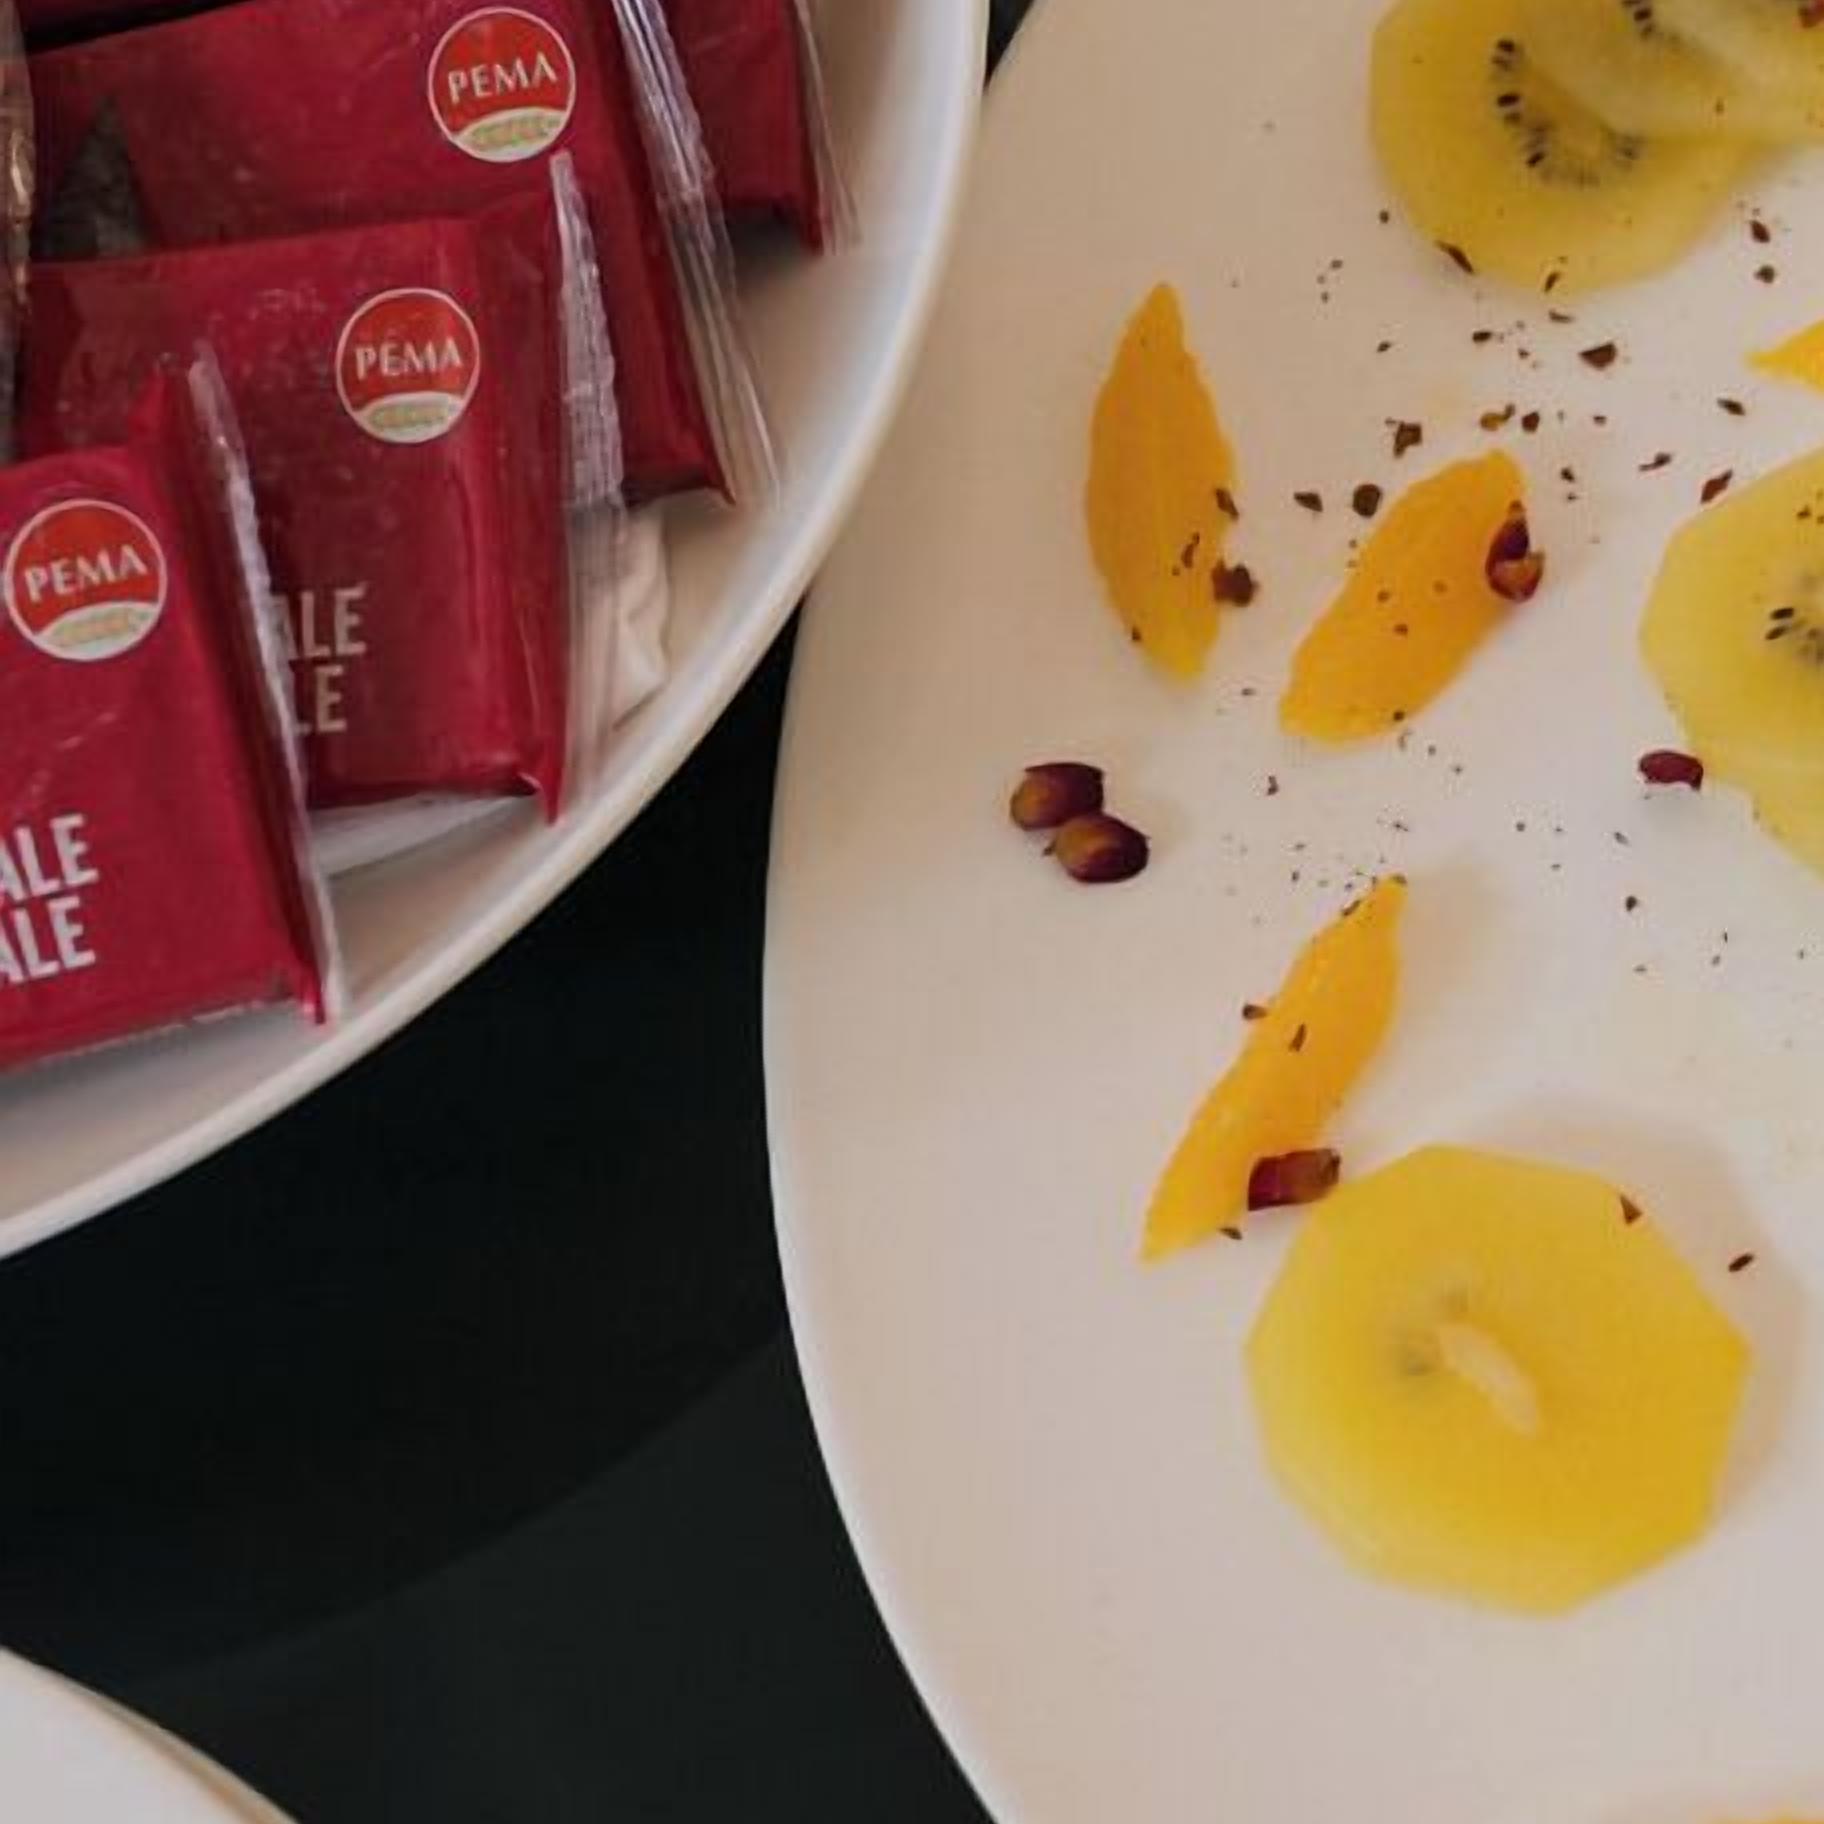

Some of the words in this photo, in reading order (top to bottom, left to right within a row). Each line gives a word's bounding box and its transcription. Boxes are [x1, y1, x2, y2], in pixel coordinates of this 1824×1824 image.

[448, 50, 558, 105] PEMA
[355, 335, 464, 382] PEMA
[23, 543, 148, 604] PEMA
